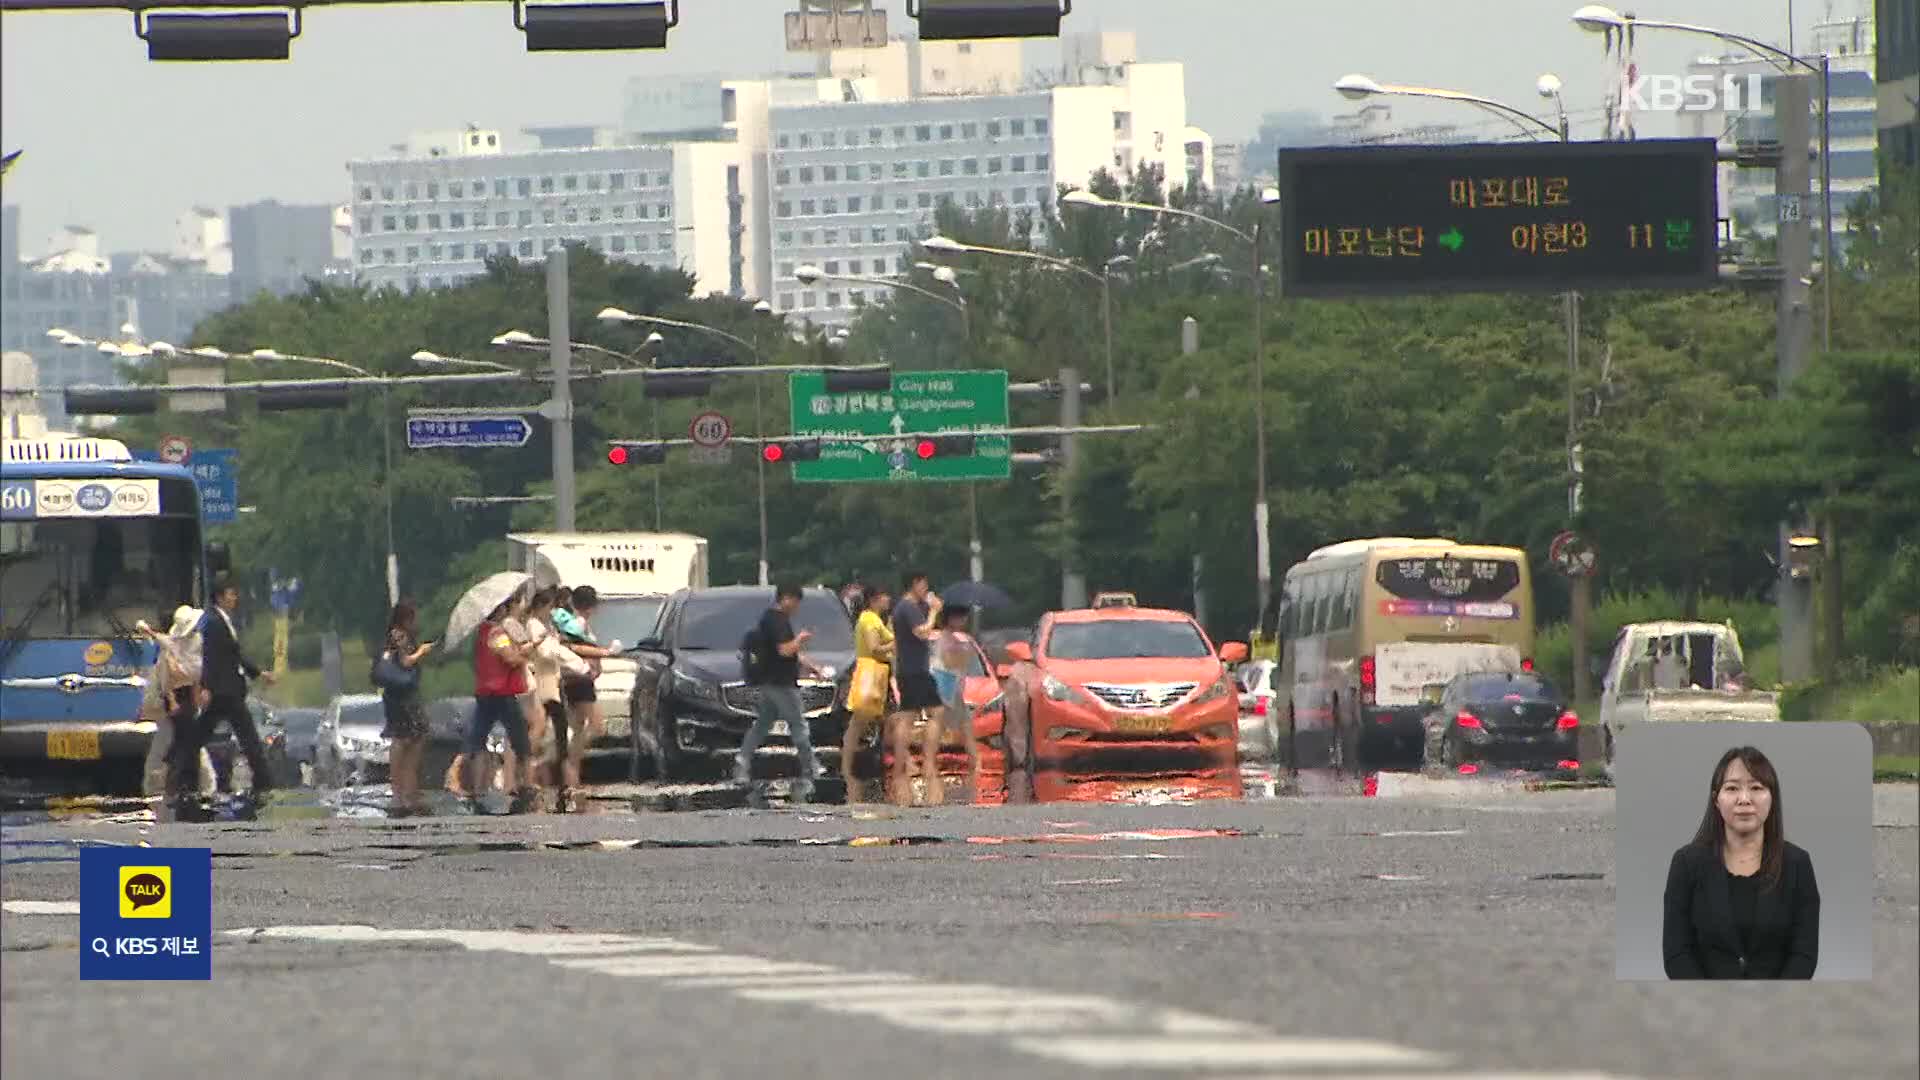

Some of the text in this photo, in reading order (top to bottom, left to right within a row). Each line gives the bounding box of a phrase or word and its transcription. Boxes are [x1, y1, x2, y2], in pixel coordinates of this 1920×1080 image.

[1449, 176, 1569, 208] 마포대로
[1304, 226, 1424, 256] 마포남단
[1511, 223, 1589, 255] 아현3
[699, 422, 721, 439] 60
